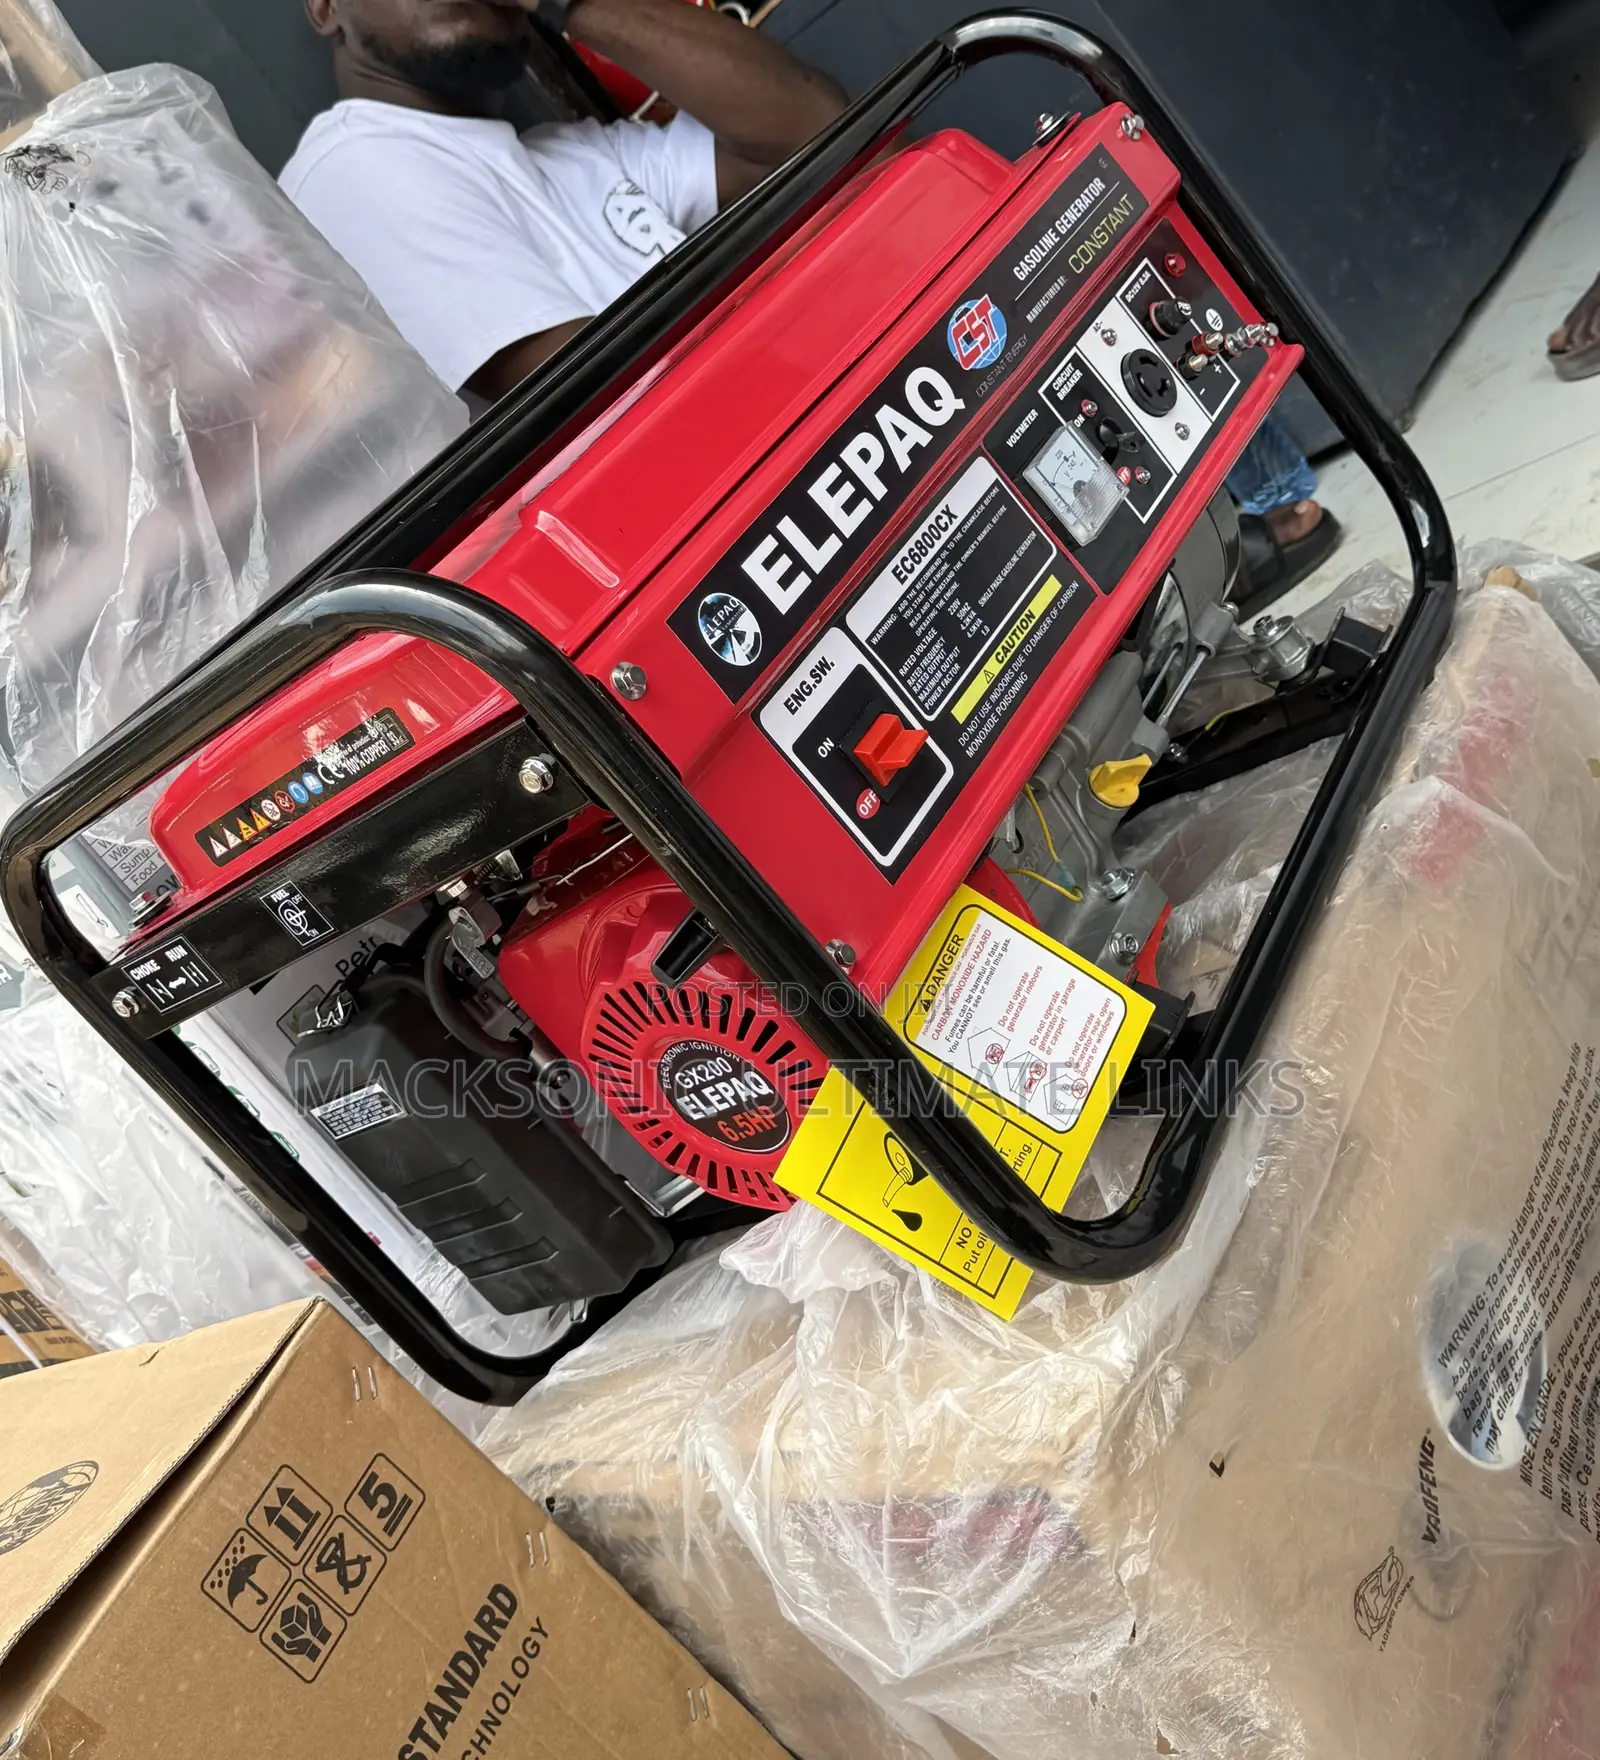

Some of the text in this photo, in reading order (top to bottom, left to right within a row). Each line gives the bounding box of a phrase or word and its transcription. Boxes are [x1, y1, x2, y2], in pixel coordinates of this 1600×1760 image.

[1012, 173, 1105, 283] GASOLINE GENERATOR
[1067, 190, 1137, 276] CONSTANT
[945, 293, 1003, 371] CST
[1025, 281, 1060, 324] MANUFACTURED
[975, 358, 1008, 398] CONSTANT
[1051, 362, 1075, 391] CIRCUIT
[1056, 368, 1082, 401] BREAKER
[1006, 408, 1039, 448] VOLTMETER
[1073, 413, 1085, 427] ON
[739, 358, 968, 615] ELEPAQ
[871, 611, 898, 645] WARNING:
[897, 598, 908, 612] ADD
[906, 588, 917, 601] THE
[915, 557, 942, 590] RECOMMEND
[983, 485, 999, 505] BEFORE
[891, 502, 958, 586] EC6800CX
[909, 504, 1007, 628] READ AND UNDERSTAND THE BEFORE
[701, 595, 739, 640] ELEPAQ
[903, 579, 934, 619] YOU START THE
[912, 530, 1037, 693] RATED OUTPUT 4.2KVA SINGLE PHASE GASOLINE GENERATOR
[915, 598, 945, 636] OPERATING THE
[898, 597, 961, 676] RATED VOLTAGE 220V
[906, 601, 971, 686] RATED FREQUENCY 50HZ
[917, 617, 983, 702] MAXIMUM OUTPUT 4.5KVA
[957, 579, 1082, 746] DO NOT USE INDOORS DUE TO DANGER OF CARBON
[993, 609, 1037, 664] CAUTION
[782, 653, 834, 715] ENG.SW.
[924, 662, 960, 709] POWER FACTOR
[964, 671, 1029, 757] MONOXIDE POISONING
[343, 753, 366, 774] 100%
[359, 738, 390, 765] COPPER
[816, 736, 835, 759] ON
[856, 789, 880, 817] OFF
[130, 860, 158, 885] Food
[270, 888, 290, 902] FUEL
[291, 893, 304, 904] OFF
[129, 944, 188, 981] CHOKE RUN
[923, 933, 966, 996] DANGER
[930, 1005, 954, 1041] CARBON
[947, 961, 976, 1005] MONOXIDE
[969, 928, 992, 962] HAZARD
[943, 939, 1001, 1042] Fumes can be harmful or fatal.
[946, 935, 1013, 1054] You CANNOT see smell this gas.
[997, 970, 1032, 1027] Do not operate
[1005, 964, 1043, 1032] generator indoors
[1028, 990, 1063, 1046] Do not operate
[1036, 977, 1079, 1051] generator in garage
[661, 1040, 739, 1089] ELECTRONIC IGNITION
[1043, 1016, 1069, 1055] or carport
[1069, 1011, 1097, 1056] not operate
[1072, 997, 1113, 1073] generator near open
[1078, 1009, 1117, 1077] doors or windows
[676, 1055, 733, 1088] GX200
[676, 1068, 773, 1120] ELEPAQ
[716, 1103, 777, 1141] 6.5HP
[954, 1225, 974, 1249] NO
[961, 1249, 981, 1273] Put
[972, 1231, 989, 1250] oil
[1436, 1096, 1569, 1369] WARNING: avoid danger suffocation,
[1486, 1154, 1567, 1319] from babies and children.
[1479, 1177, 1574, 1362] carriages playpens. This
[1527, 1241, 1562, 1297] packing
[1491, 1258, 1577, 1420] cling mouth
[1469, 1369, 1509, 1438] removing
[1517, 1368, 1557, 1486] MISE EN GARDE
[1568, 1395, 1583, 1429] dans
[1537, 1388, 1567, 1499] tenir sac hors
[357, 1473, 399, 1518] 5
[1378, 1574, 1414, 1651] YAOFENG POWER
[393, 1580, 522, 1760] STANDARD
[460, 1615, 549, 1760] CHNOLOGY
